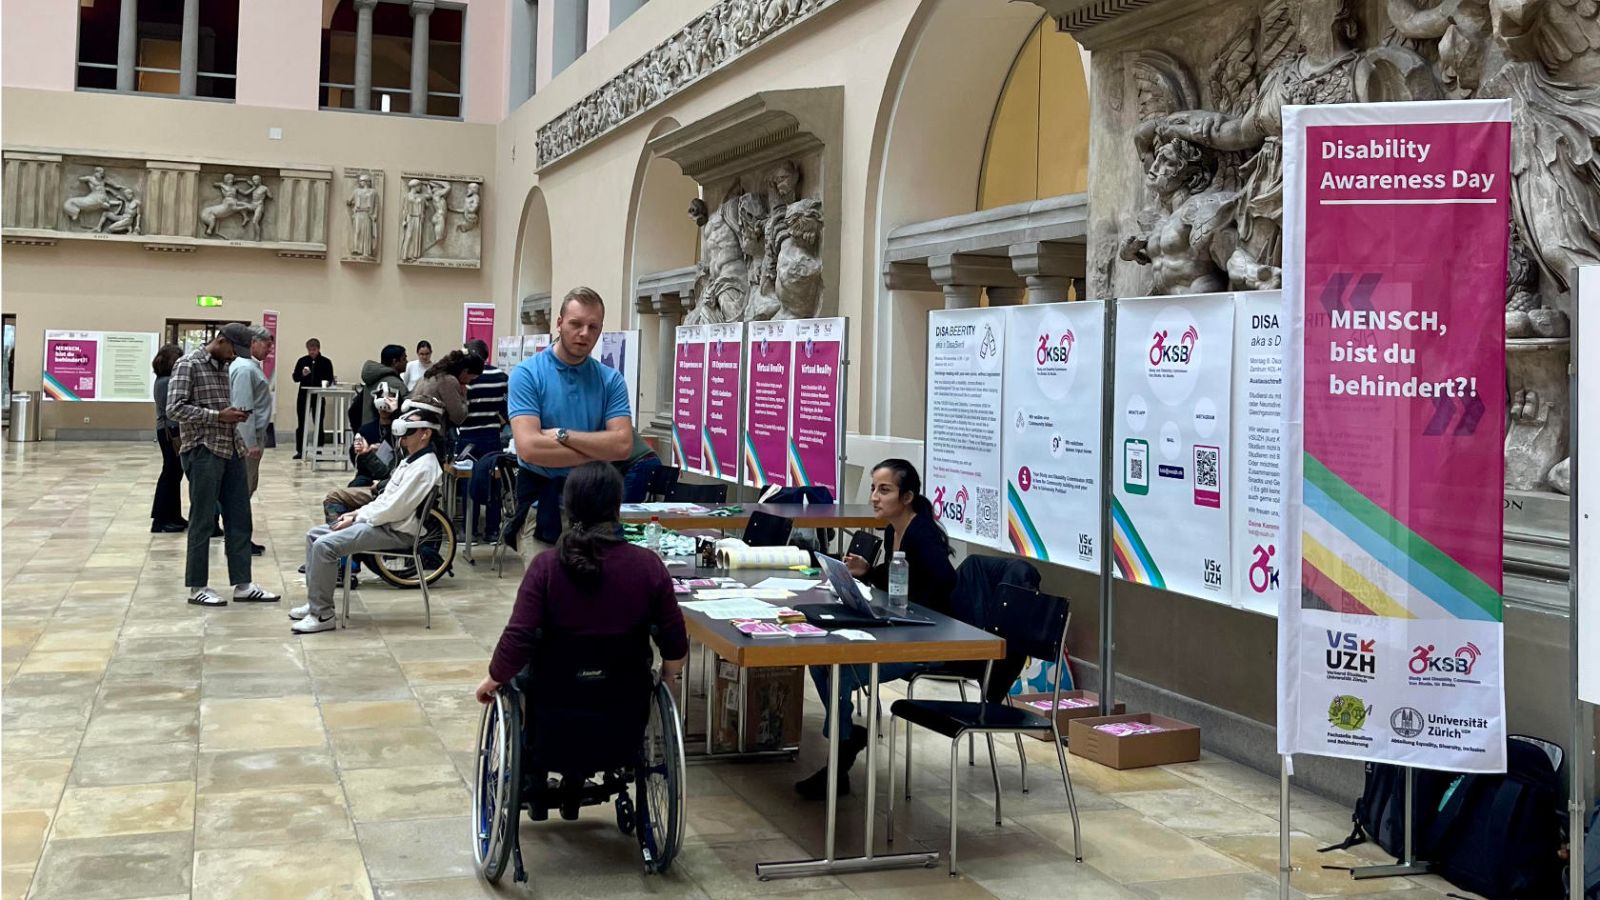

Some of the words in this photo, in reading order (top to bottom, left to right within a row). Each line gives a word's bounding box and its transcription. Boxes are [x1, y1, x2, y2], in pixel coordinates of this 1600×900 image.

[1322, 139, 1430, 162] Disability
[1320, 171, 1446, 190] Awareness
[1452, 169, 1495, 192] Day
[1252, 314, 1279, 329] DISA
[1331, 309, 1447, 335] MENSCH,
[1251, 335, 1266, 347] aka
[1163, 345, 1189, 362] KSB
[1330, 341, 1377, 364] bist
[1384, 343, 1415, 364] du
[1330, 373, 1477, 397] behindert?!
[1204, 570, 1221, 585] UZH
[1326, 629, 1358, 651] VS
[1326, 649, 1375, 674] UZH
[1429, 656, 1468, 673] KSB
[1428, 714, 1488, 728] Universität
[1428, 726, 1461, 739] Zürich
